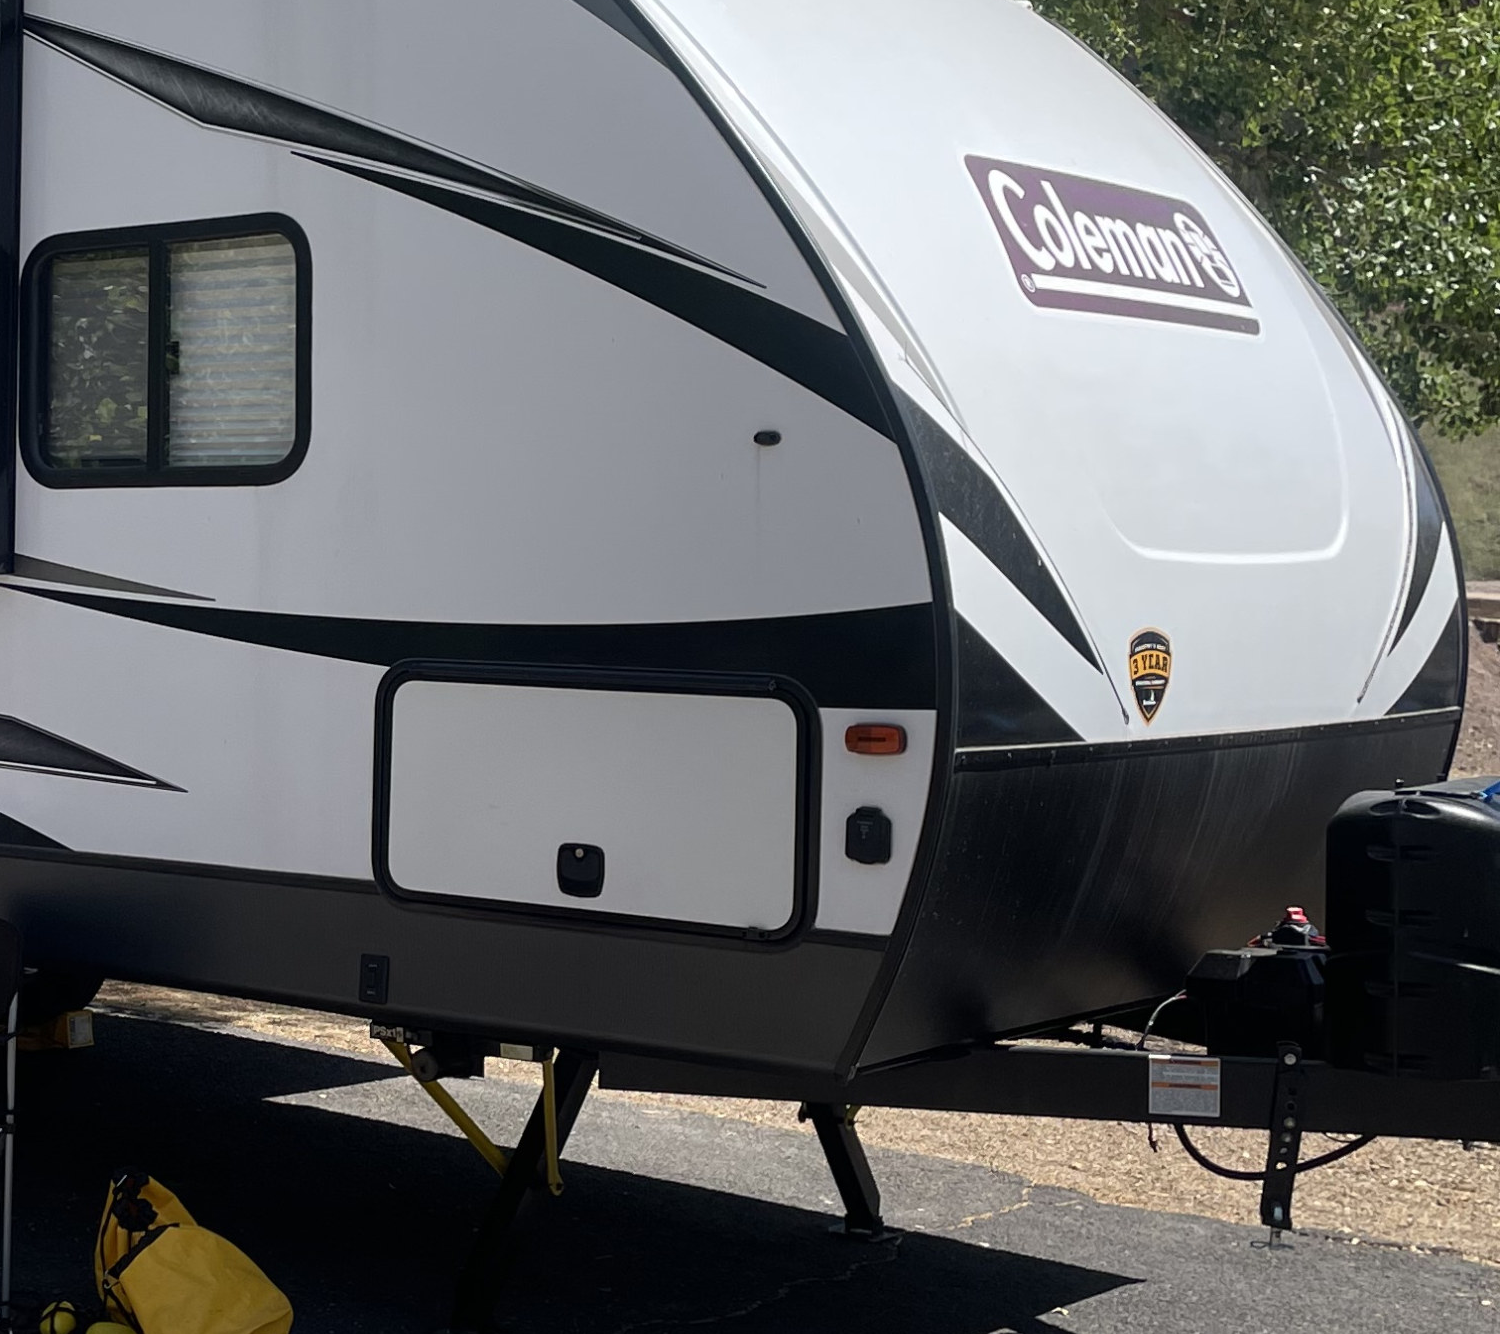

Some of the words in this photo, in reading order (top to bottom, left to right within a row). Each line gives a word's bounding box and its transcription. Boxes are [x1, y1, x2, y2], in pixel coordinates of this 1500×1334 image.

[988, 169, 1204, 288] Coleman
[1133, 658, 1139, 675] 3
[1142, 653, 1168, 673] YEAR
